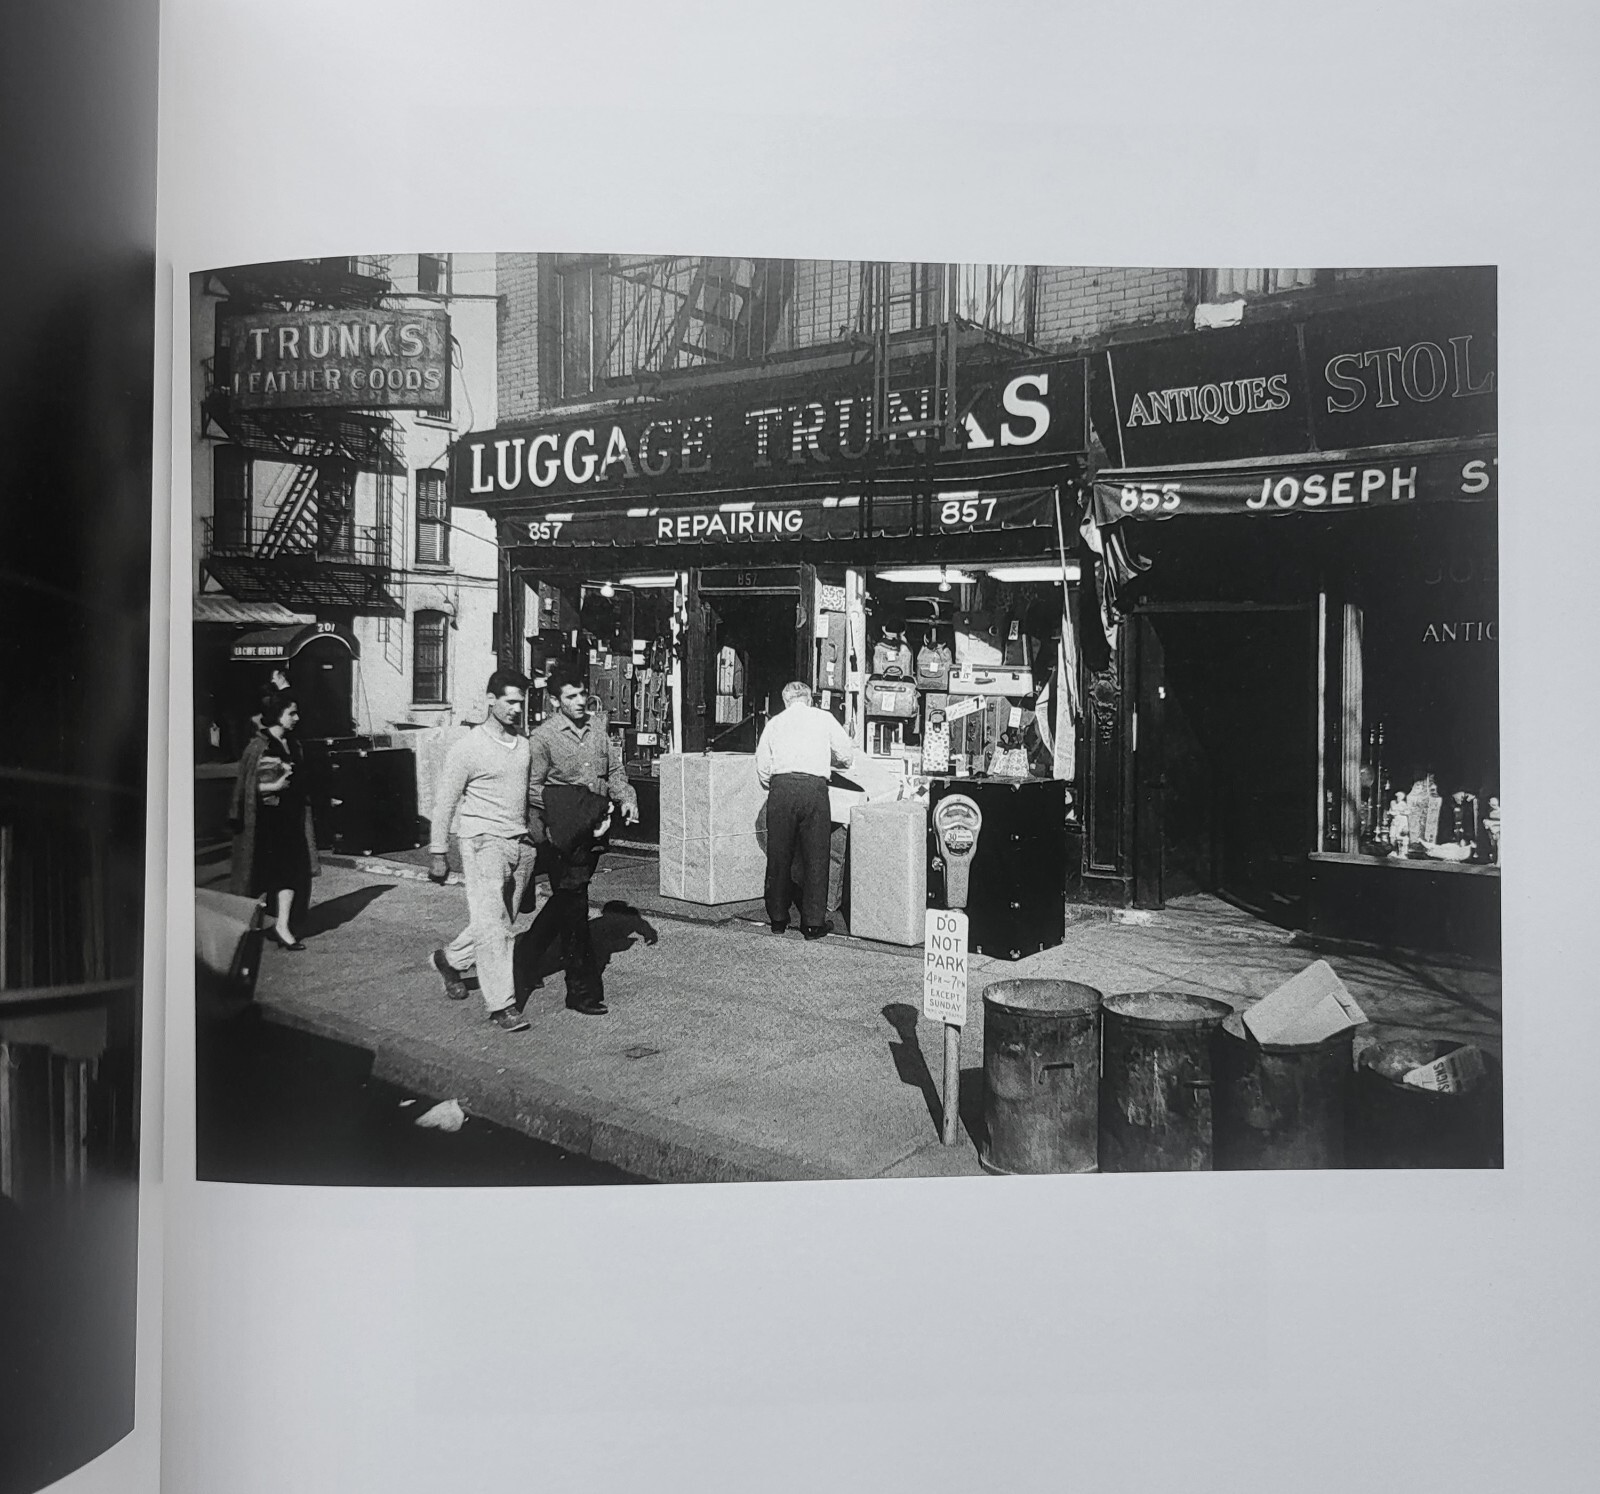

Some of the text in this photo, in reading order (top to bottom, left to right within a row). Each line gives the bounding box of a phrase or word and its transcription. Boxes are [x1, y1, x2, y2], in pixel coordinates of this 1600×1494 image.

[249, 323, 425, 360] TRUNKS
[350, 367, 443, 391] GOODS
[1324, 335, 1495, 413] STOL
[1126, 373, 1291, 428] ANTIQUES
[469, 373, 1051, 494] LUGGAGE TRUNKS
[1245, 465, 1418, 510] JOSEPH
[1460, 457, 1498, 494] S
[939, 497, 998, 525] 857
[527, 521, 563, 540] 857
[657, 510, 804, 539] REPAIRING
[936, 916, 957, 933] DO
[931, 934, 962, 953] NOT
[926, 952, 965, 974] PARK
[929, 998, 962, 1013] SUNDAY
[930, 988, 961, 1002] EXCEPT
